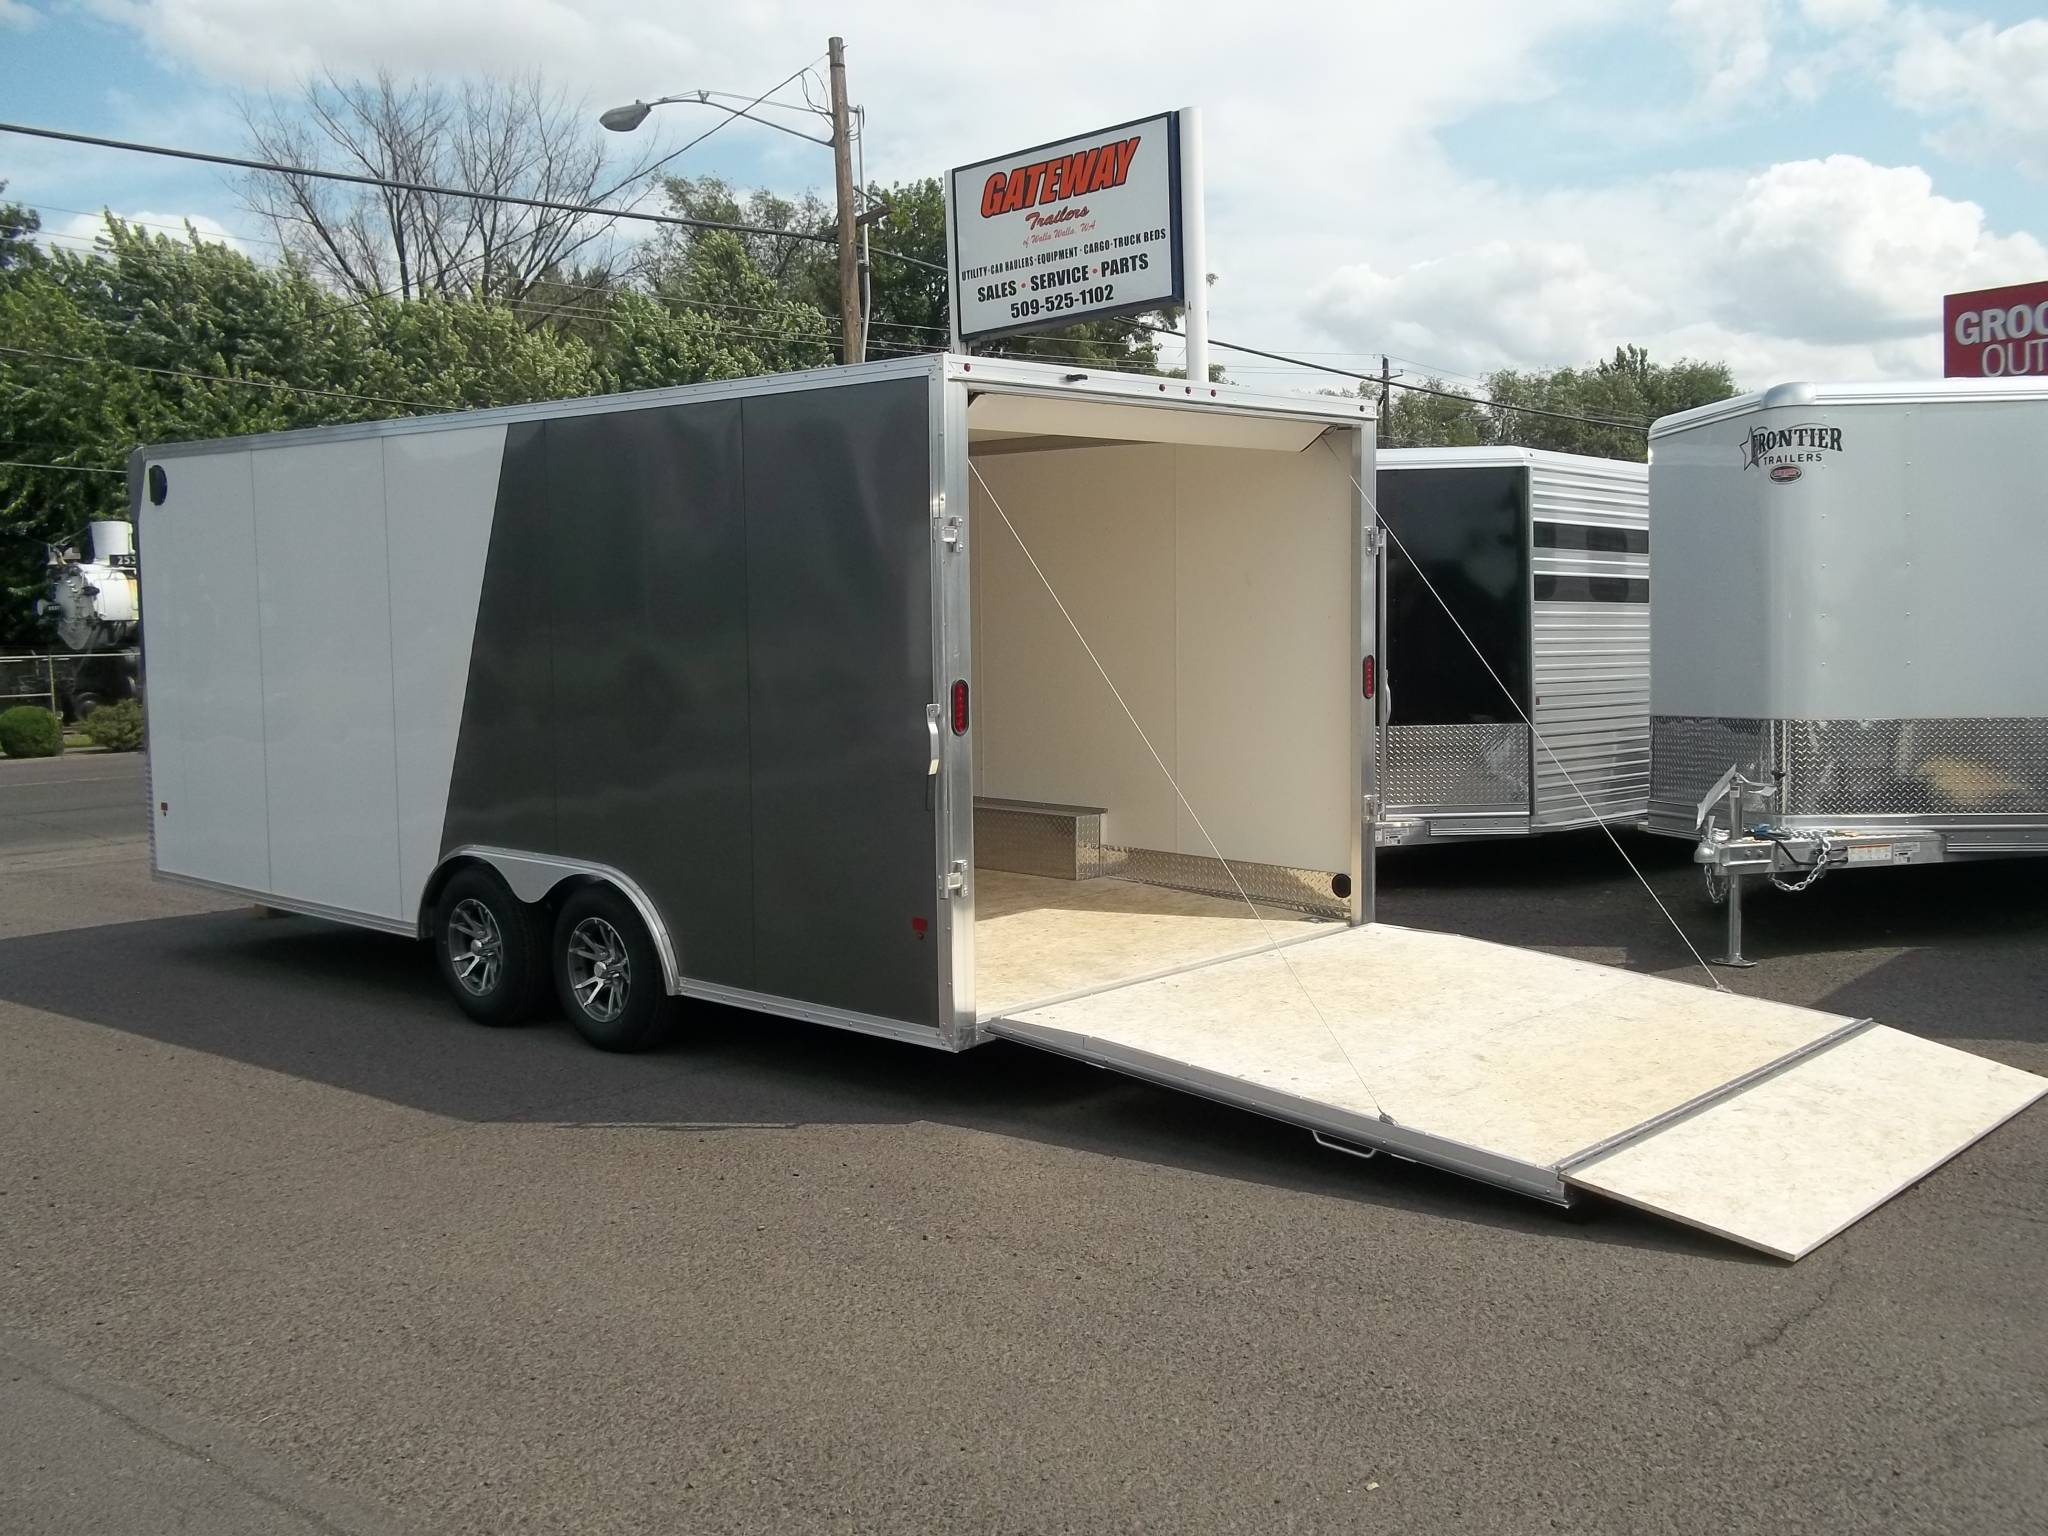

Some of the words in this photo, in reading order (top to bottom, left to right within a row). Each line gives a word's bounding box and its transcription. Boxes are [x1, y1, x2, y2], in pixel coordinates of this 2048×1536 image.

[981, 136, 1141, 218] GATEWAY
[1025, 206, 1089, 230] Trailers
[961, 266, 988, 281] UTILITY
[990, 262, 1004, 275] CAR
[1005, 256, 1034, 272] HAULERS
[1037, 246, 1078, 264] EQUIPMENT
[1083, 240, 1110, 254] CARGO
[1113, 233, 1142, 249] TRUCK
[1143, 228, 1166, 242] BEDS
[977, 280, 1017, 303] SALES
[1030, 265, 1089, 291] SERVICE
[1101, 253, 1149, 277] PARTS
[1010, 284, 1114, 319] 509-525-1102
[1752, 428, 1843, 454] FRONTIER
[1763, 453, 1823, 465] TRAILERS
